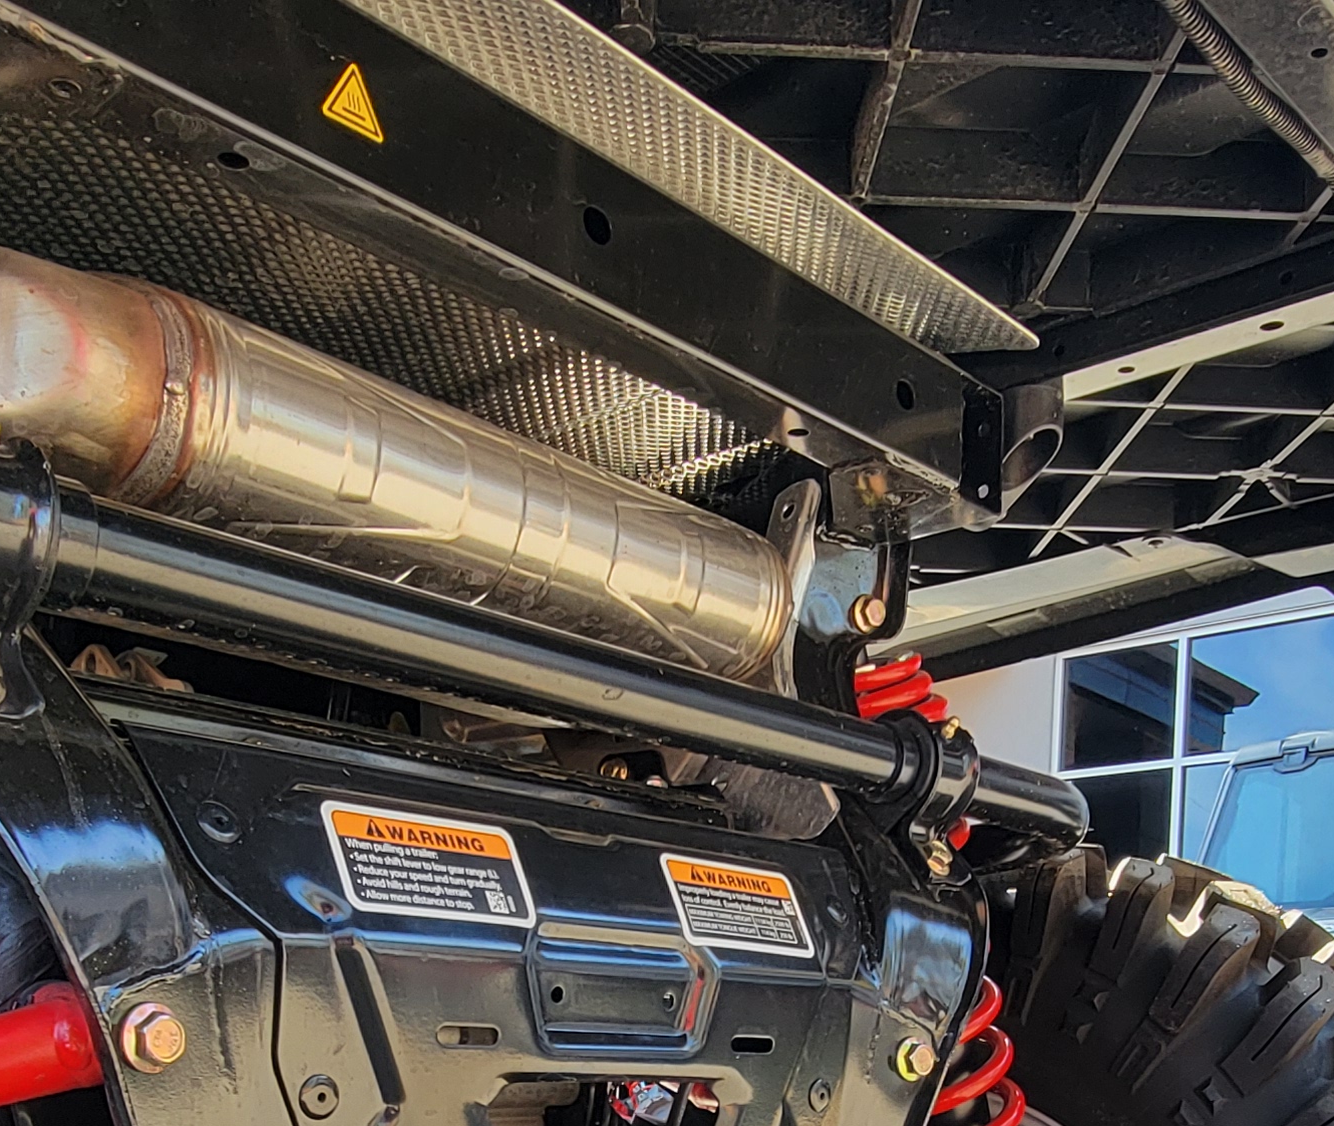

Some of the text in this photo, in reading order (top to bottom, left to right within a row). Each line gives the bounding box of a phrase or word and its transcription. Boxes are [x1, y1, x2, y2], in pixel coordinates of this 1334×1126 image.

[344, 837, 373, 851] When
[373, 843, 404, 857] pulling
[405, 848, 411, 856] a
[385, 824, 485, 852] WARNING
[354, 852, 368, 862] Set
[369, 853, 383, 864] the
[384, 856, 402, 867] shift
[402, 858, 421, 869] lever
[422, 861, 432, 870] to
[432, 862, 447, 872] low
[447, 865, 465, 876] gear
[465, 868, 487, 879] range
[357, 864, 389, 877] Reduce
[389, 869, 408, 879] your
[409, 872, 433, 883] speed
[433, 874, 449, 884] and
[449, 876, 467, 886] turn
[362, 876, 386, 888] Avoid
[387, 879, 403, 890] hills
[404, 882, 420, 892] and
[420, 884, 445, 897] rough
[703, 870, 772, 893] WARNING
[366, 889, 389, 901] Allow
[390, 894, 412, 903] more
[412, 894, 445, 907] distance
[445, 898, 455, 908] to
